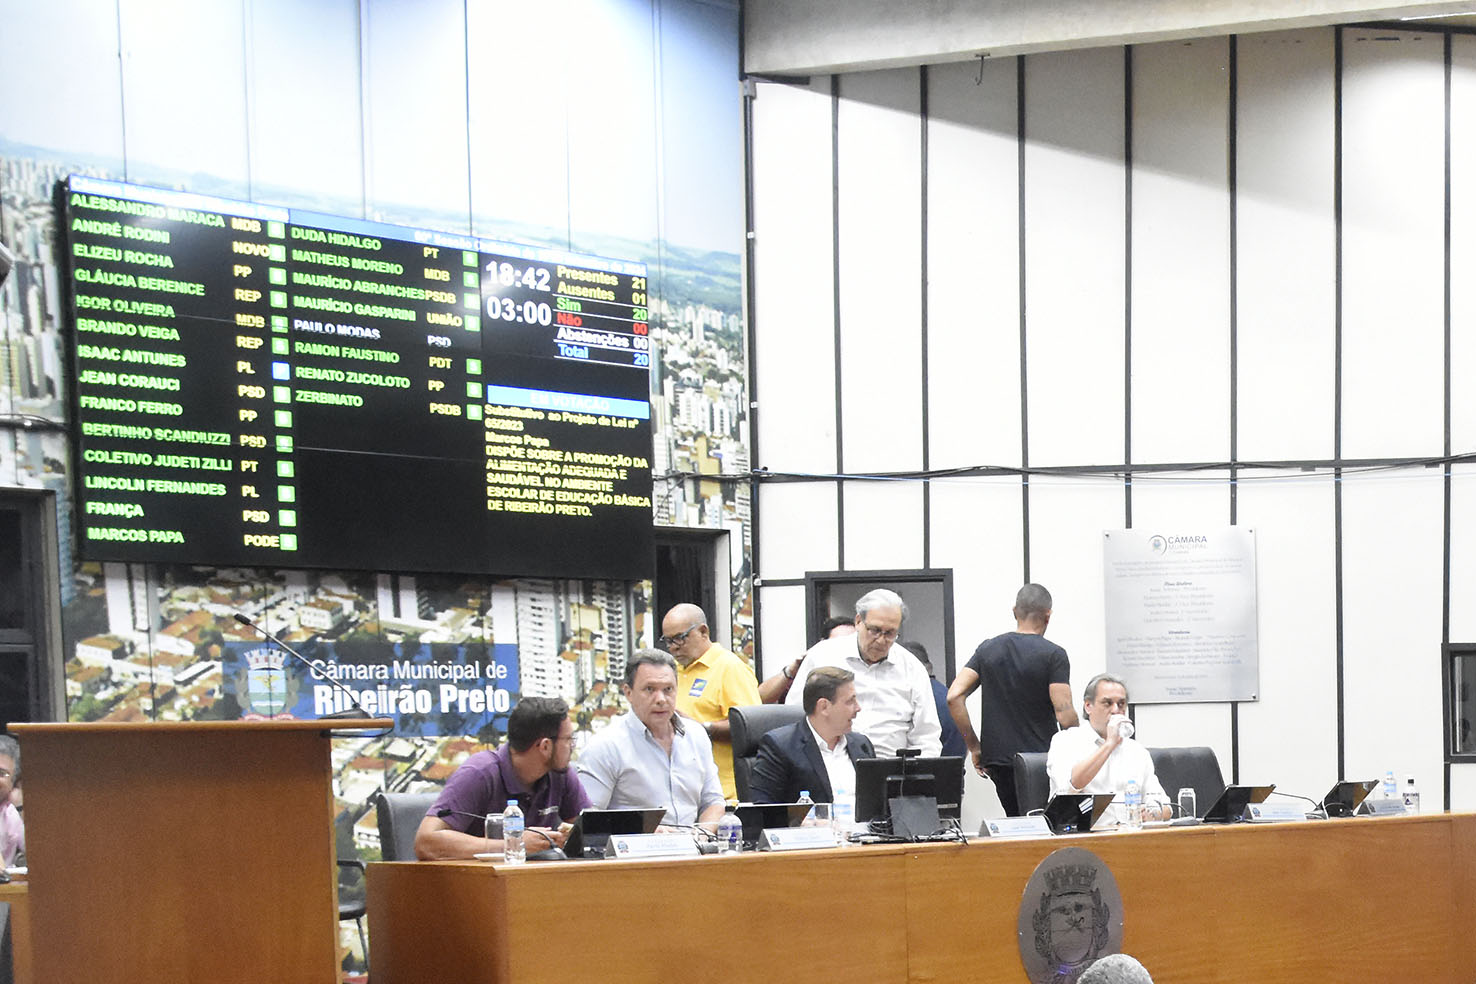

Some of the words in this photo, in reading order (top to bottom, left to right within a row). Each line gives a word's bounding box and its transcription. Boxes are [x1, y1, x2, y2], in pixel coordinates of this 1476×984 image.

[71, 193, 166, 219] ALESSANDRO
[72, 218, 122, 238] ANDRÉ
[123, 226, 170, 244] RODINI
[231, 217, 262, 233] MDB
[291, 227, 327, 243] DUDA
[328, 233, 382, 251] HIDALGO
[73, 243, 123, 262] ELIZEU
[124, 250, 174, 269] ROCHA
[232, 241, 270, 258] NOVO
[423, 246, 439, 259] PT
[233, 264, 252, 278] PP
[292, 249, 350, 267] MATHEUS
[351, 257, 404, 275] MORENO
[74, 268, 136, 289] GLÁUCIA
[137, 277, 205, 297] BERENICE
[424, 268, 450, 282] MDB
[486, 260, 551, 292] 18:42
[557, 265, 618, 286] Presentes
[632, 276, 646, 290] 21
[235, 288, 262, 303] REP
[292, 271, 352, 290] MAURÍCIO
[353, 280, 425, 301] ABRANCHES
[557, 281, 615, 301] Ausentes
[632, 292, 646, 306] 01
[76, 295, 112, 311] IGOR
[114, 301, 176, 318] OLIVEIRA
[425, 289, 456, 304] PSDB
[293, 295, 353, 314] MAURÍCIO
[354, 303, 417, 322] GASPARINI
[486, 296, 551, 327] 03:00
[557, 297, 582, 312] Sim
[633, 308, 647, 321] 20
[77, 318, 138, 337] BRANDO
[139, 324, 180, 341] VEIGA
[236, 314, 265, 328] MDB
[294, 319, 335, 334] PAULO
[337, 324, 381, 340] MODAS
[426, 311, 463, 328] UNIÃO
[557, 312, 582, 327] Não
[633, 322, 647, 335] 00
[236, 335, 264, 350] REP
[427, 335, 452, 347] PSD
[557, 326, 630, 348] Abstenções
[633, 337, 648, 350] 00
[77, 345, 120, 362] ISAAC
[122, 349, 187, 367] ANTUNES
[295, 341, 339, 357] RAMON
[342, 347, 400, 364] FAUSTINO
[429, 356, 453, 369] PDT
[558, 343, 588, 359] Total
[634, 353, 648, 366] 20
[237, 361, 256, 374] PL
[295, 366, 345, 382] RENATO
[346, 371, 411, 389] ZUCOLOTO
[79, 370, 117, 386] JEAN
[118, 374, 180, 391] CORAUCI
[428, 379, 445, 391] PP
[238, 384, 266, 399] PSD
[295, 390, 364, 408] ZERBINATO
[530, 392, 549, 405] EM
[80, 396, 137, 412] FRANCO
[138, 400, 183, 416] FERRO
[239, 409, 258, 422] PP
[430, 402, 461, 416] PSDB
[548, 411, 562, 421] ao
[562, 412, 597, 426] Projeto
[598, 416, 611, 426] de
[611, 416, 627, 428] Lei
[82, 422, 152, 440] BERTINHO
[153, 427, 231, 446] SCANDIUZZI
[239, 434, 267, 448] PSD
[485, 430, 523, 445] Marcos
[523, 434, 550, 448] Papa
[83, 449, 153, 466] COLETIVO
[154, 454, 201, 470] JUDETI
[201, 458, 233, 471] ZILLI
[241, 460, 259, 473] PT
[486, 444, 526, 458] DISPÕE
[526, 448, 563, 462] SOBRE
[564, 451, 574, 463] A
[573, 452, 632, 468] PROMOÇÃO
[633, 457, 649, 469] DA
[561, 463, 619, 479] ADEQUADA
[619, 469, 628, 480] E
[85, 475, 145, 492] LINCOLN
[146, 479, 227, 496] FERNANDES
[241, 485, 260, 498] PL
[486, 472, 544, 487] SAUDÁVEL
[544, 476, 561, 488] NO
[561, 478, 614, 492] AMBIENTE
[486, 486, 539, 500] ESCOLAR
[539, 489, 555, 501] DE
[555, 489, 613, 506] EDUCAÇÃO
[613, 493, 651, 507] BÁSICA
[86, 501, 145, 519] FRANÇA
[243, 509, 270, 523] PSD
[487, 499, 503, 511] DE
[504, 501, 554, 515] RIBEIRÃO
[555, 504, 593, 517] PRETO.
[87, 527, 148, 543] MARCOS
[149, 530, 185, 544] PAPA
[244, 534, 280, 548] PODE
[310, 658, 389, 681] Câmara
[393, 659, 480, 684] Municipal
[486, 661, 507, 680] de
[314, 684, 433, 715] Ribeirão
[440, 685, 510, 714] Preto
